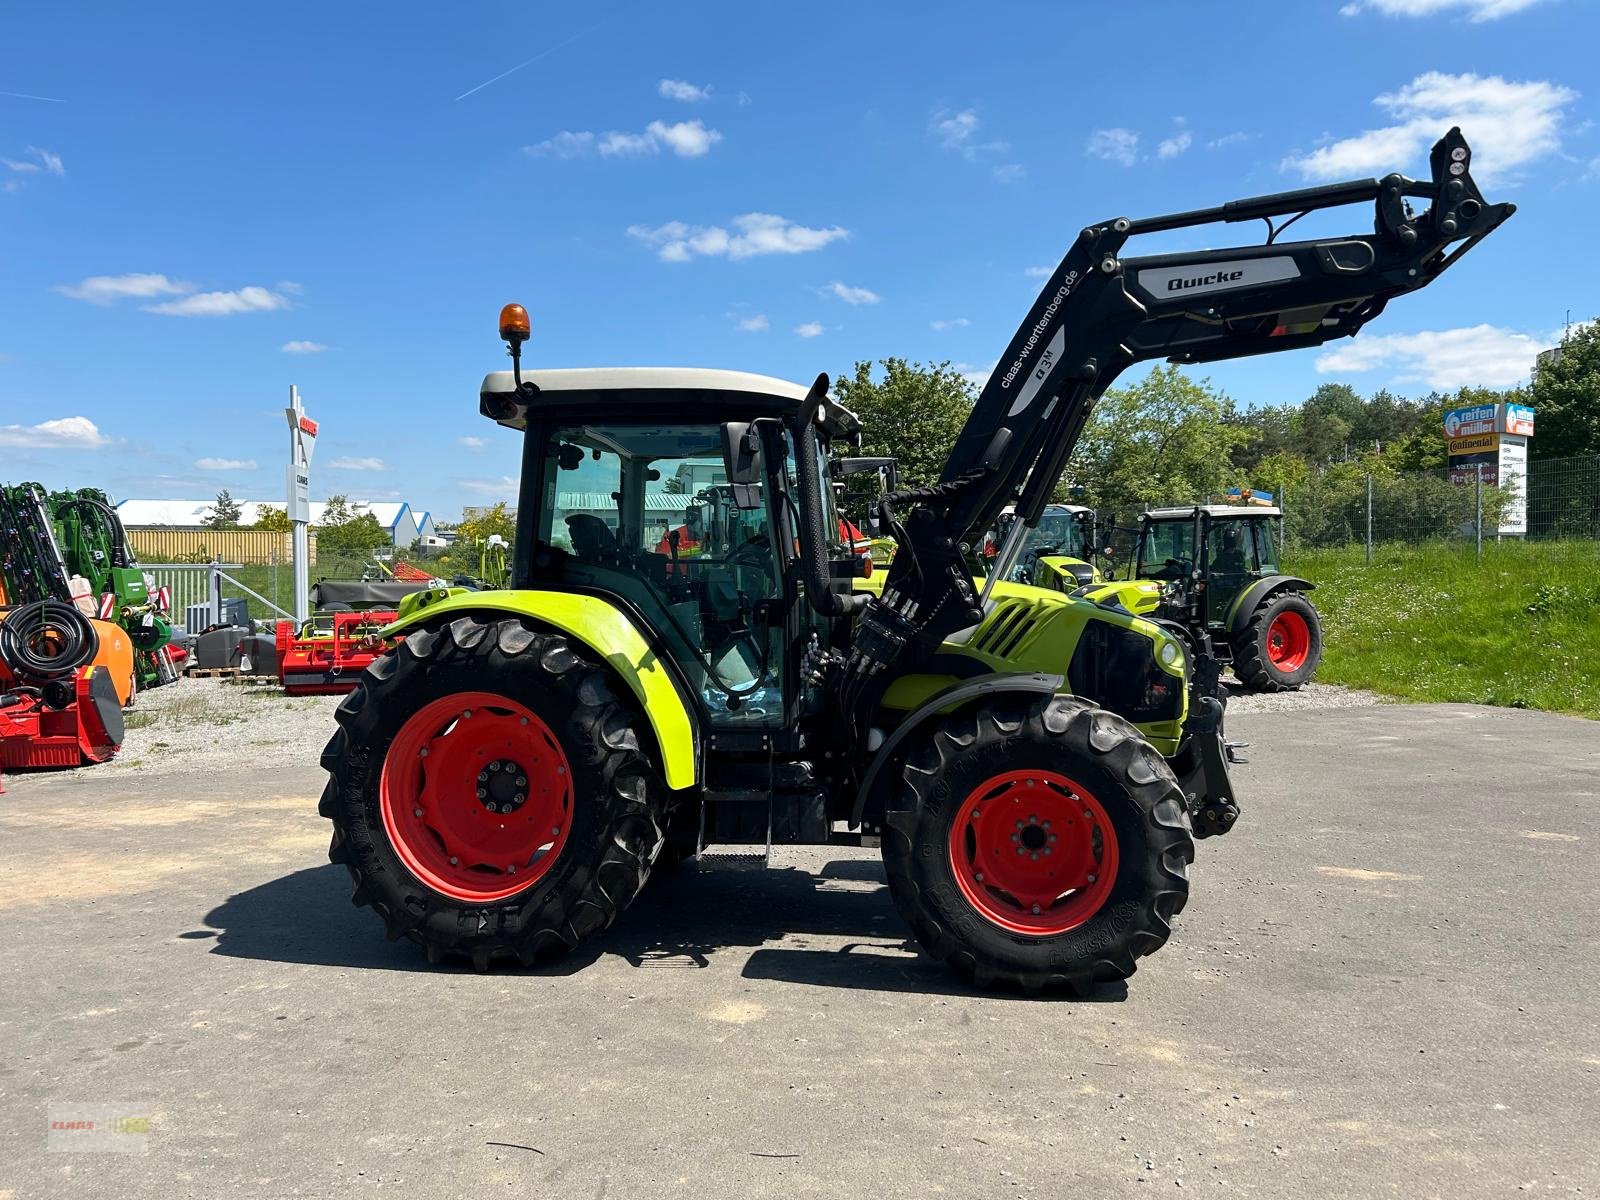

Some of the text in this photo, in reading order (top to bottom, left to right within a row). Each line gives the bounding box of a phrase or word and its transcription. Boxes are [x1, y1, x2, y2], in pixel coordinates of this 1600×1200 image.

[1167, 270, 1243, 291] Quicke
[1001, 270, 1078, 389] claas-wuerttemberg.de
[1461, 408, 1493, 421] reifen
[1461, 422, 1492, 435] müller
[1450, 436, 1492, 452] Continental
